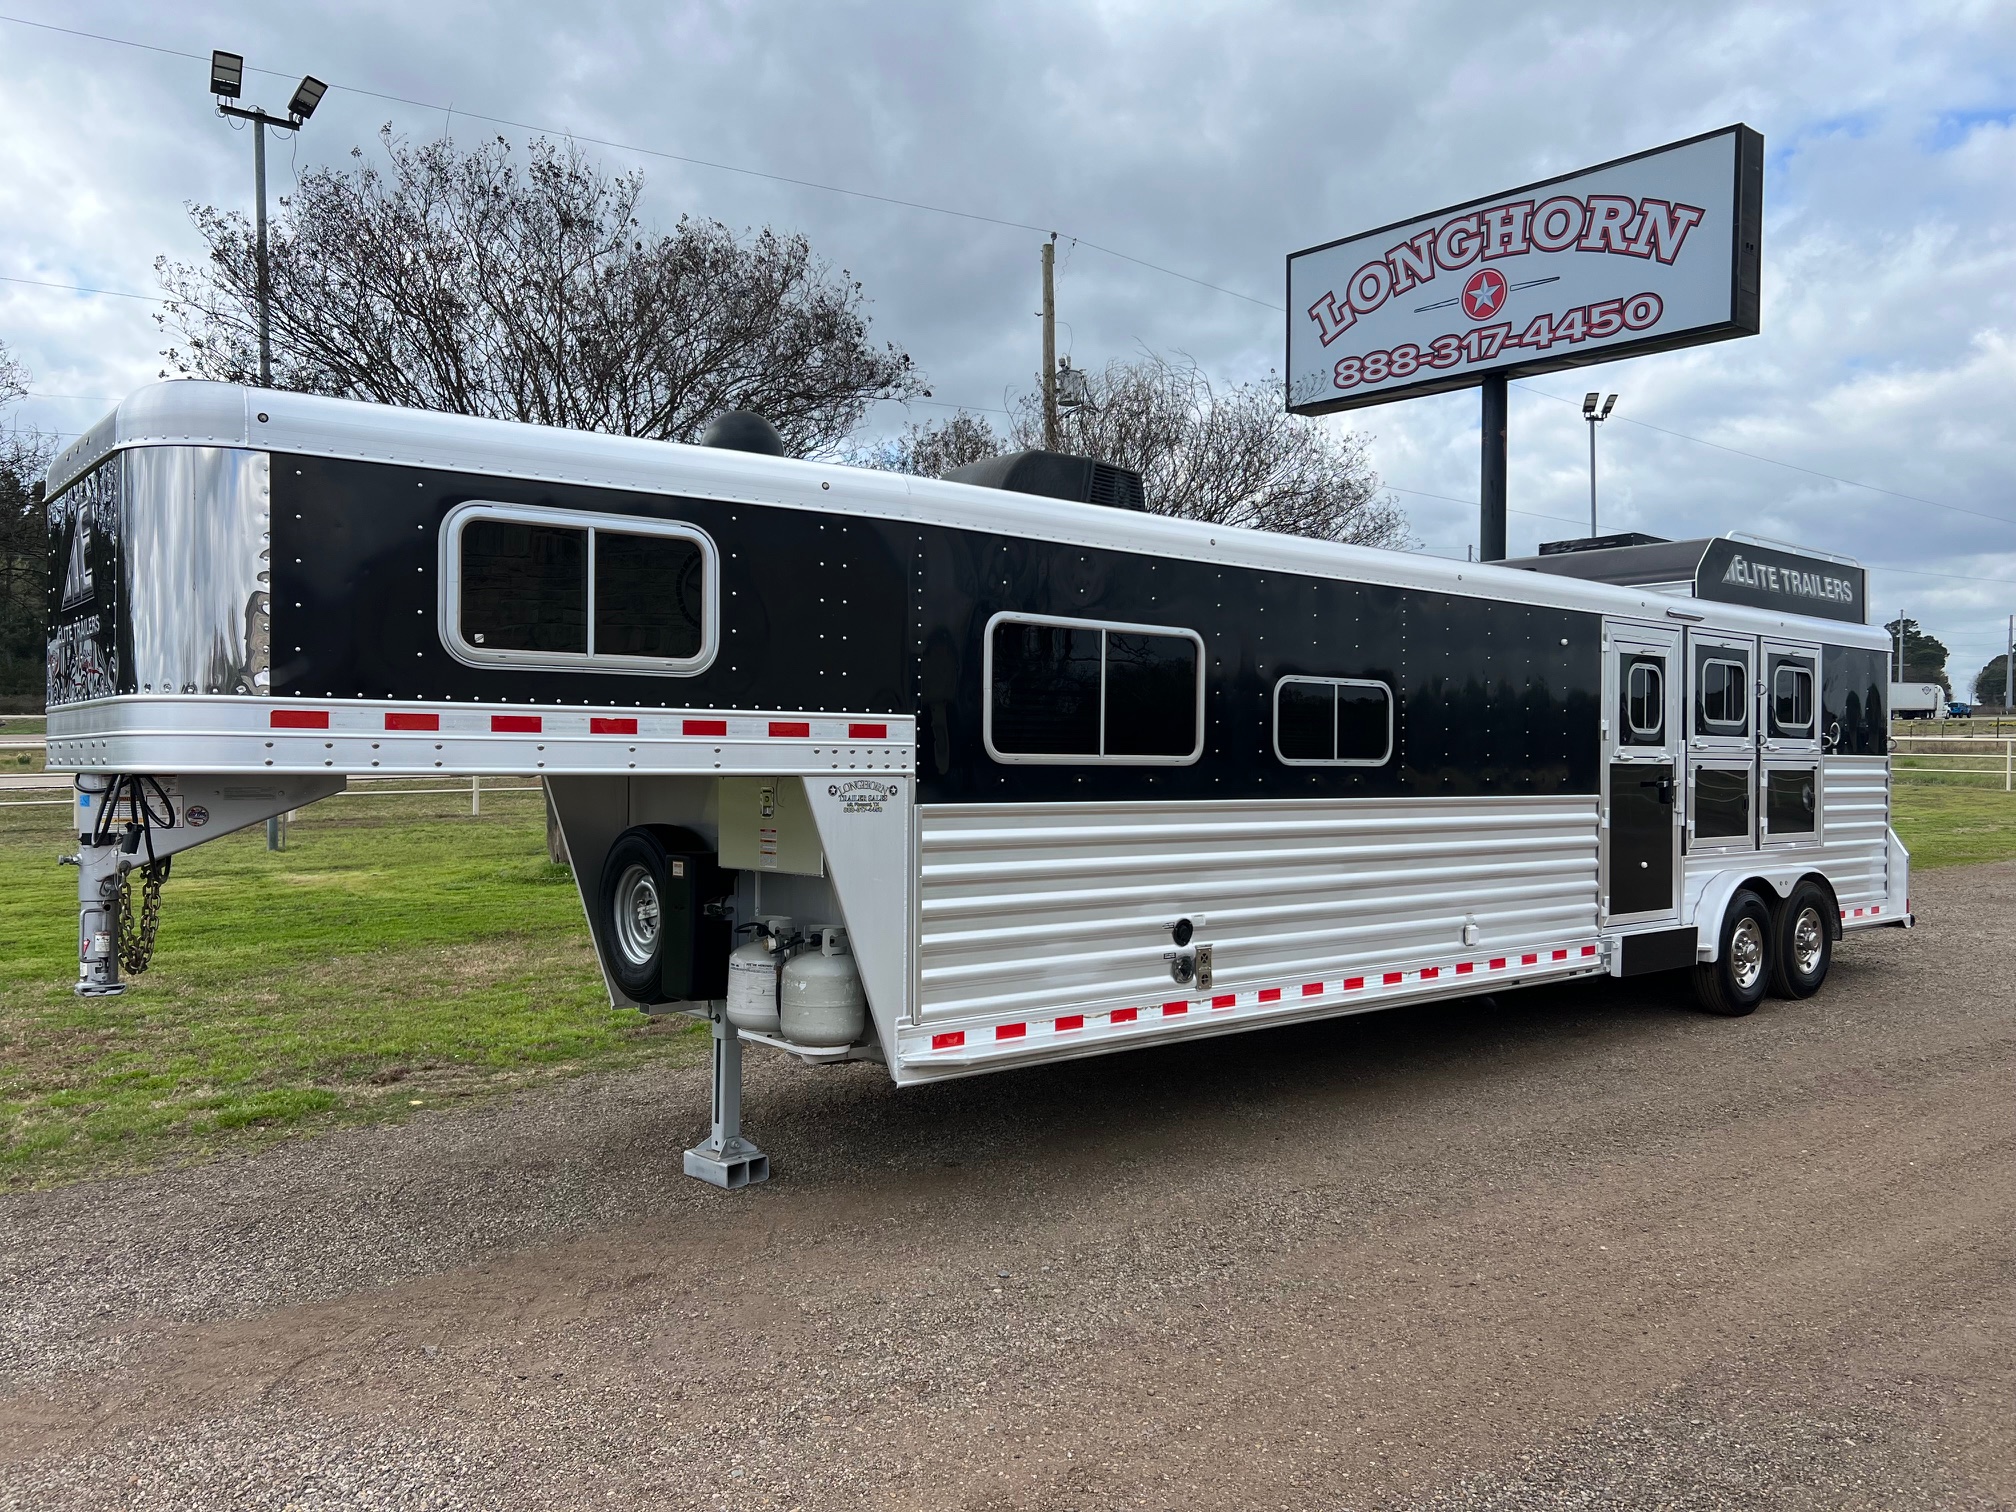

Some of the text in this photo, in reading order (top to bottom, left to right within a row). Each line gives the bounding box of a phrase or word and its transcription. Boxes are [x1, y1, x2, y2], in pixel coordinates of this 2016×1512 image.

[1308, 195, 1706, 347] LONGHORN
[1334, 292, 1664, 389] 888-317-4450
[1779, 568, 1853, 604] TRAILERS
[837, 780, 889, 795] LONGHORN
